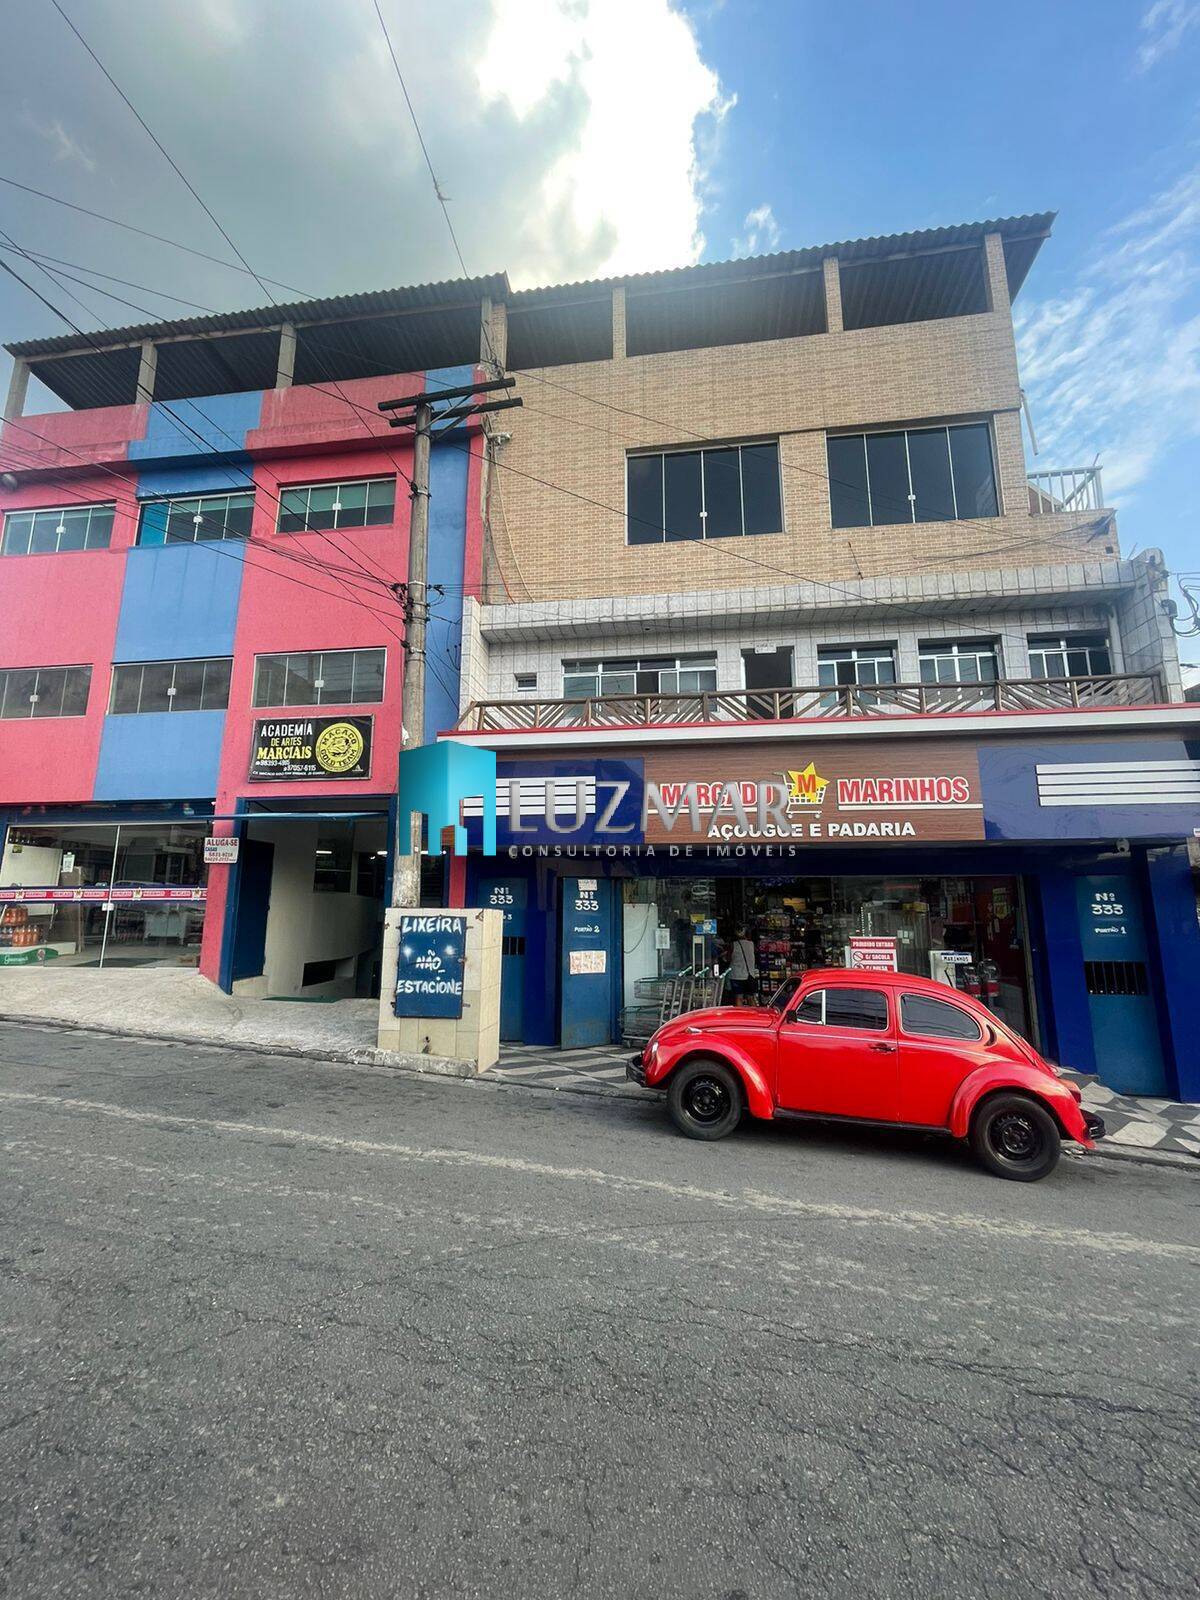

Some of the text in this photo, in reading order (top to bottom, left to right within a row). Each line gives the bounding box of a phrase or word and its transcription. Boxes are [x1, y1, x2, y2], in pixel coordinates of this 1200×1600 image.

[261, 723, 313, 737] ACADEMIA
[322, 729, 357, 745] MACACO
[271, 737, 302, 746] DE ARTES
[257, 746, 312, 760] MARCIAIS
[321, 748, 357, 766] GOLD TEAM
[837, 776, 970, 805] MARINHOS
[707, 822, 916, 840] AÇOUGUE E PADARIA
[489, 895, 514, 904] 333
[575, 900, 599, 911] 333
[1091, 904, 1124, 915] 333
[402, 916, 463, 934] LIXEIRA
[594, 925, 600, 933] 2
[1120, 926, 1127, 934] 1
[416, 949, 442, 970] NÃO
[396, 976, 463, 995] ESTACIONE
